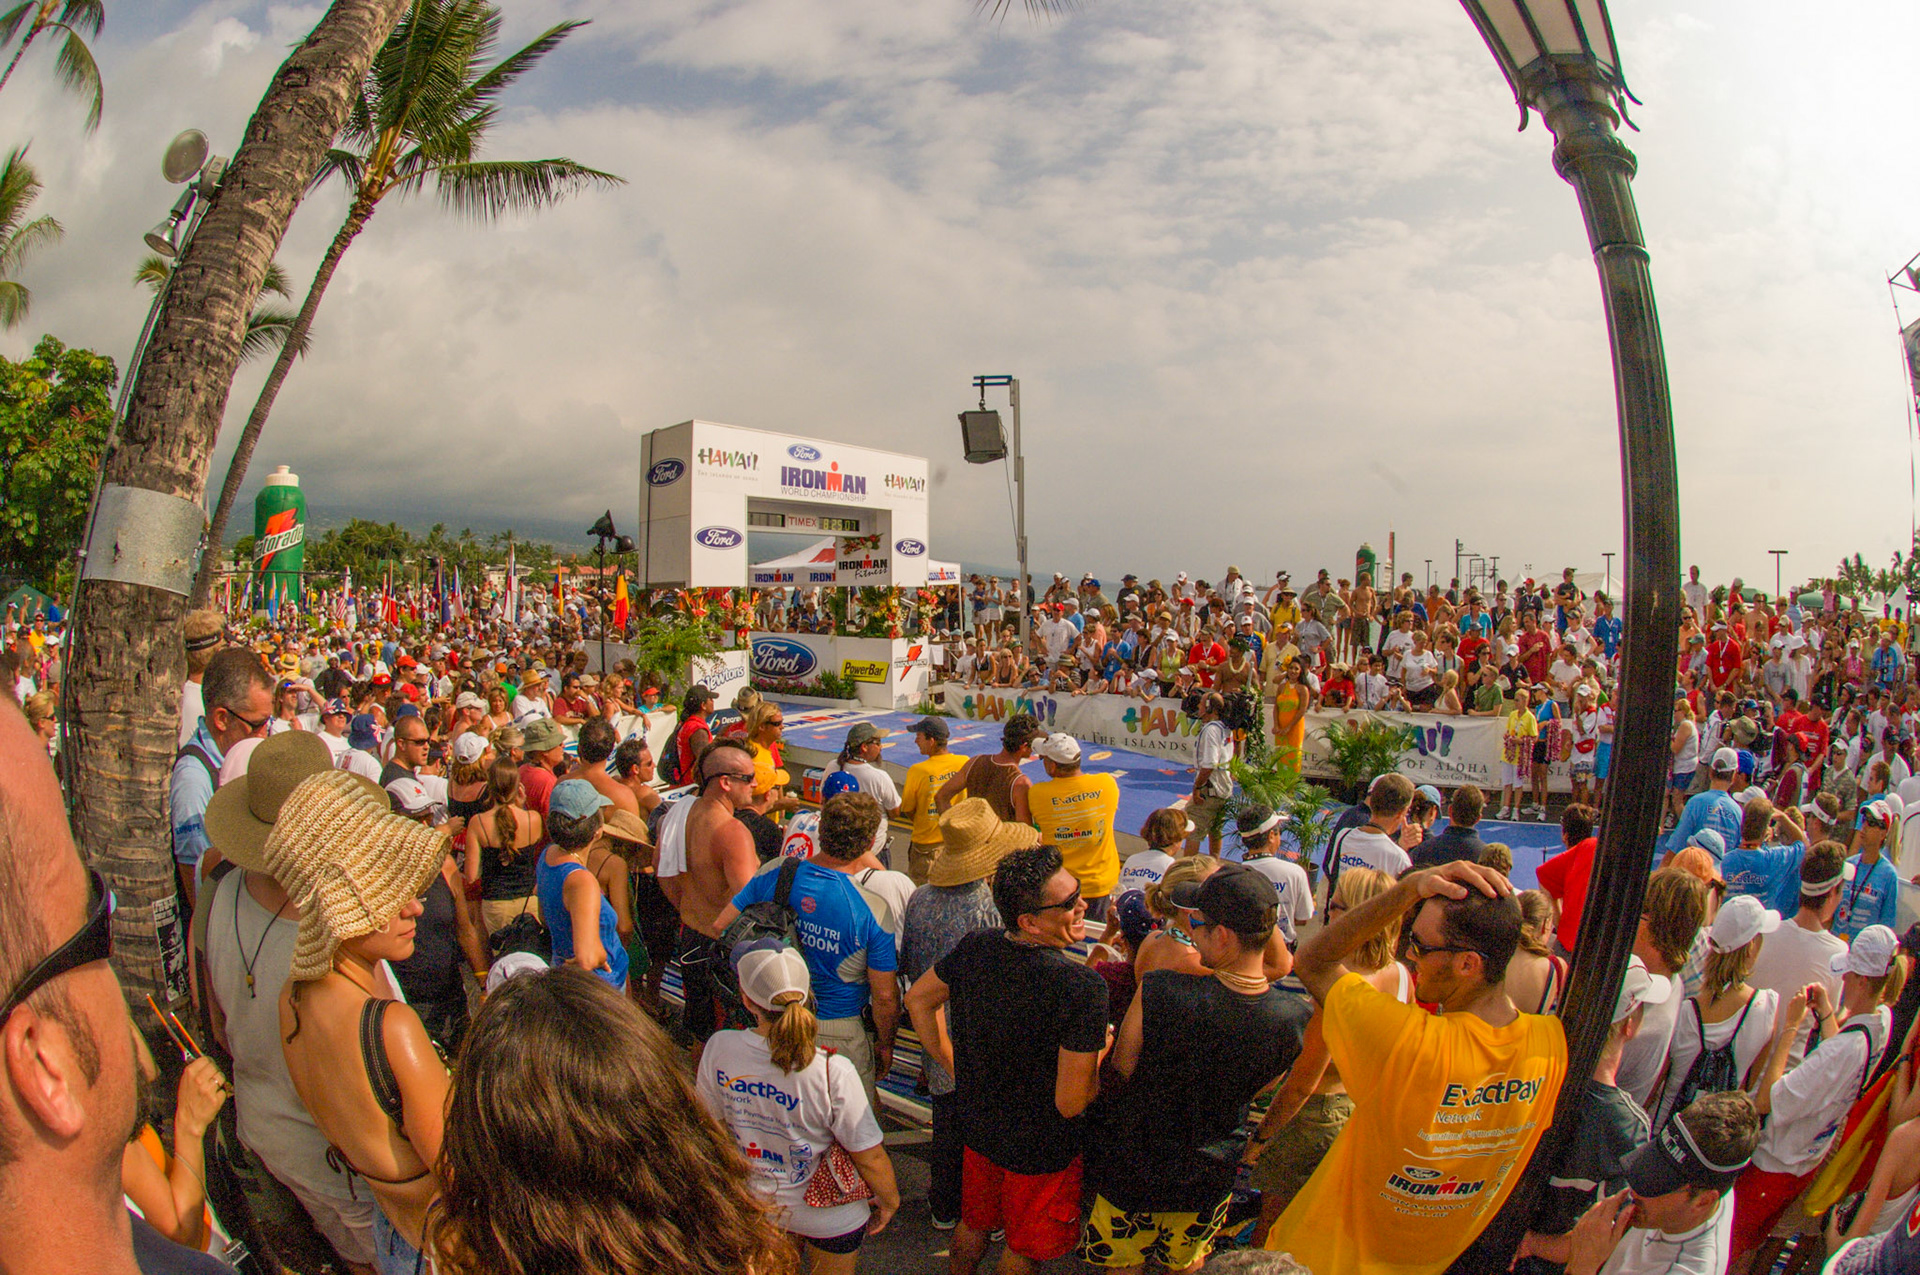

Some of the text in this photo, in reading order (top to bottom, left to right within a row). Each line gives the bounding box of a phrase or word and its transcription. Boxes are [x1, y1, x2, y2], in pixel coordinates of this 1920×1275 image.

[794, 445, 816, 460] Ford
[653, 463, 678, 483] Ford
[781, 461, 867, 495] IRONMAN
[780, 486, 867, 503] WORLD CHAMPIONSHIP
[788, 516, 817, 528] TIMEX
[704, 528, 735, 547] Ford
[900, 540, 921, 555] Ford
[838, 553, 888, 571] IRONMAN
[754, 568, 794, 583] IRONMAN
[855, 567, 888, 580] Fitness
[753, 642, 801, 674] Ford
[844, 661, 885, 677] PowerBar
[1091, 730, 1116, 746] THE
[1124, 737, 1188, 752] ISLANDS
[1406, 759, 1488, 774] OF ALOHA
[1051, 790, 1102, 806] ExactPay
[1123, 867, 1162, 883] ExactPay
[803, 920, 822, 936] YOU
[823, 927, 841, 942] TRI
[800, 931, 840, 955] ZOOM
[716, 1069, 800, 1111] ExactPay
[1440, 1074, 1544, 1108] ExactPay
[1387, 1173, 1486, 1196] IRONMAN
